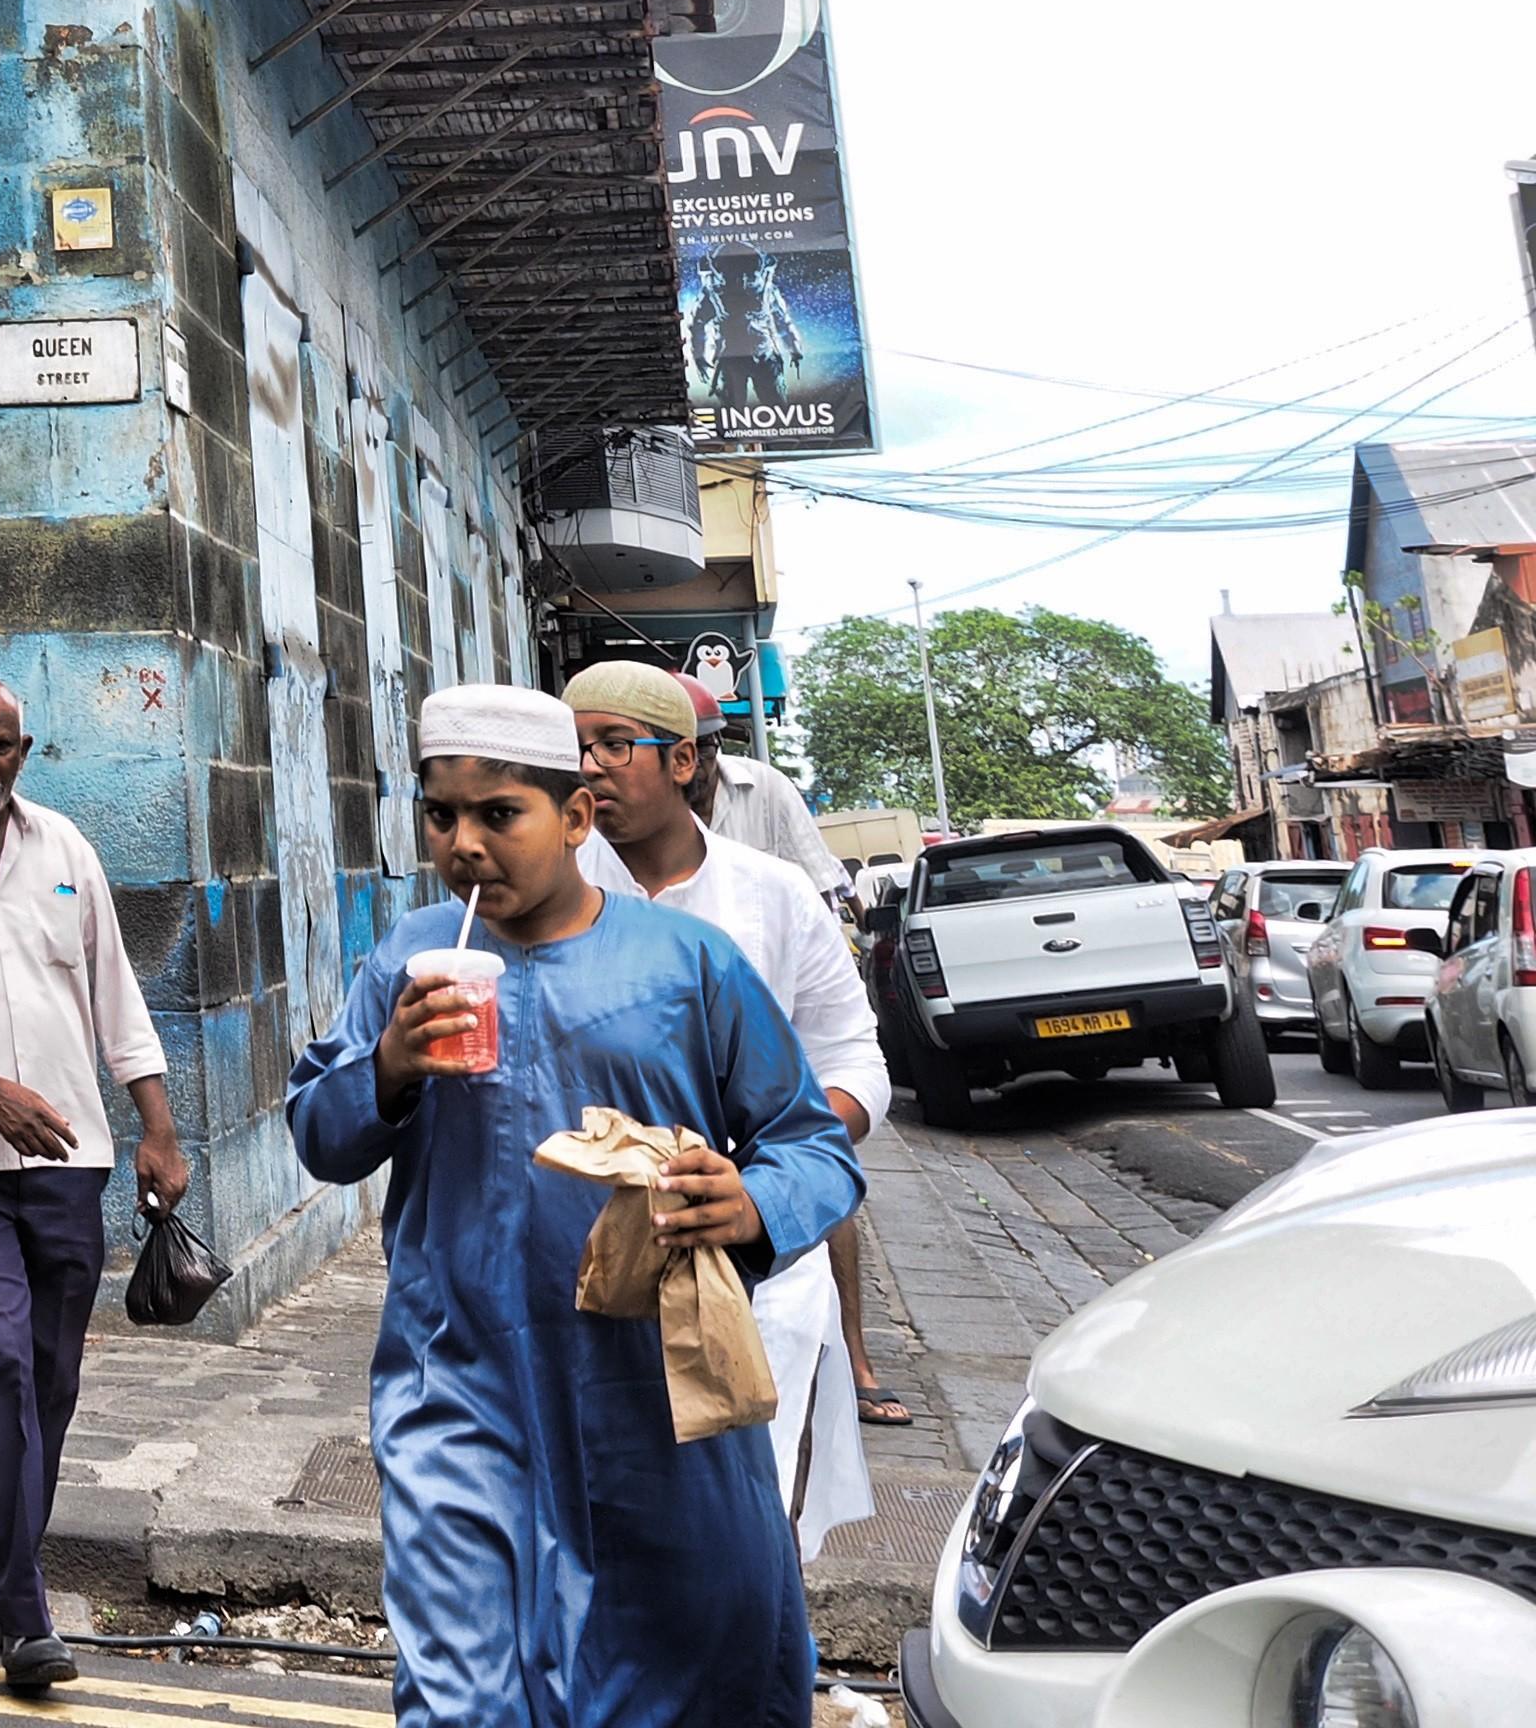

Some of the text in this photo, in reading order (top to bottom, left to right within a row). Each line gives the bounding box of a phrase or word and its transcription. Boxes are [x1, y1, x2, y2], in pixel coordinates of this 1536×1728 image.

[672, 191, 795, 213] EXCLUSIVE IP
[708, 207, 815, 227] SOLUTIONS
[32, 337, 93, 358] QUEEN
[36, 372, 90, 386] STREET
[721, 403, 834, 429] INOVUS
[724, 425, 835, 438] AUTHORIZED DISTRIBUTOR
[1045, 1018, 1081, 1034] 1694
[1106, 1012, 1122, 1028] 14
